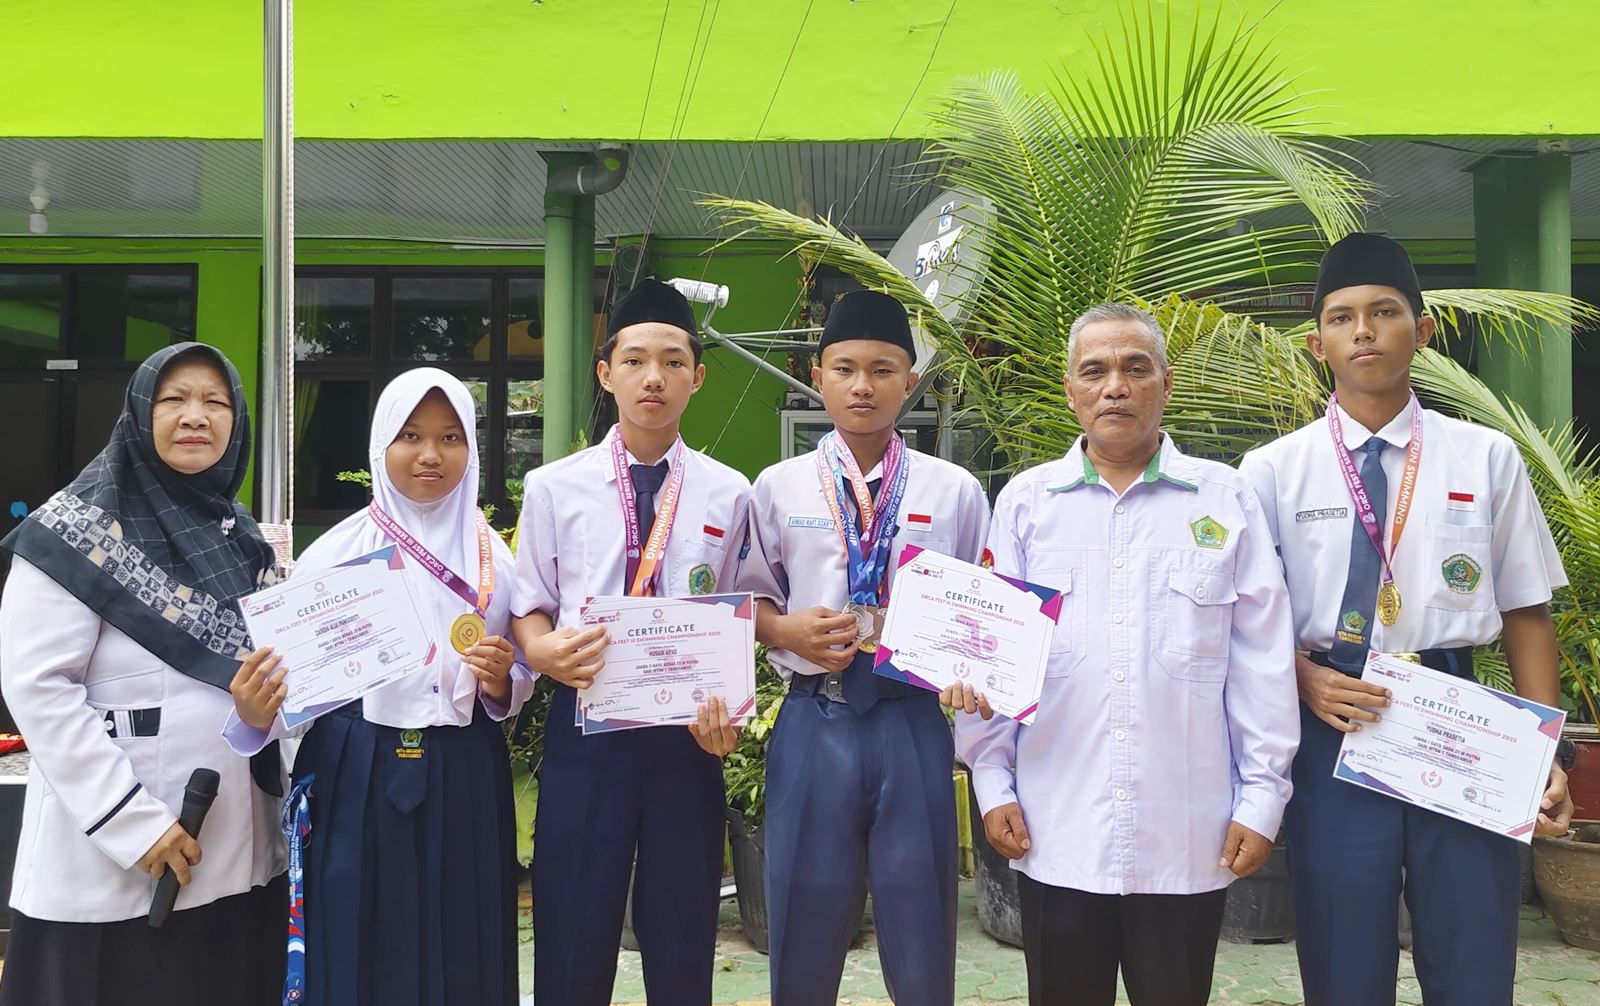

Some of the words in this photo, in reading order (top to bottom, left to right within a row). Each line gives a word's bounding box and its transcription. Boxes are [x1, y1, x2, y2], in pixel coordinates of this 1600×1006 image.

[1328, 419, 1346, 442] METRO
[1336, 441, 1352, 465] SERIES
[1407, 441, 1419, 463] FUN
[618, 454, 628, 477] METRO
[1346, 464, 1355, 473] III
[622, 477, 632, 499] SERIES
[819, 468, 833, 488] FUN
[850, 471, 865, 492] FUN
[895, 477, 907, 497] SERIES
[1349, 471, 1362, 488] FEST
[663, 481, 678, 504] FUN
[1356, 487, 1371, 510] ORCA
[1394, 464, 1415, 525] SWIMMING
[373, 507, 392, 524] METRO
[627, 507, 636, 523] FEST
[388, 521, 409, 540] SERIES
[405, 536, 414, 545] III
[630, 524, 639, 545] ORCA
[645, 503, 670, 561] SWIMMING
[411, 542, 427, 556] FEST
[424, 553, 444, 571] ORCA
[476, 535, 492, 586] SWIMMING
[296, 586, 359, 618] CERTIFICATE
[920, 593, 934, 601] ORCA
[951, 602, 977, 612] SWIMMING
[977, 609, 1012, 622] CHAMPIONSHIP
[944, 590, 1004, 613] CERTIFICATE
[274, 624, 290, 634] ORCA
[289, 619, 302, 628] FEST
[627, 623, 695, 636] CERTIFICATE
[666, 631, 707, 639] CHAMPIONSHIP
[1399, 701, 1413, 709] FEST
[1419, 707, 1453, 722] SWIMMING
[1453, 718, 1501, 738] CHAMPIONSHIP
[1412, 695, 1490, 727] CERTIFICATE
